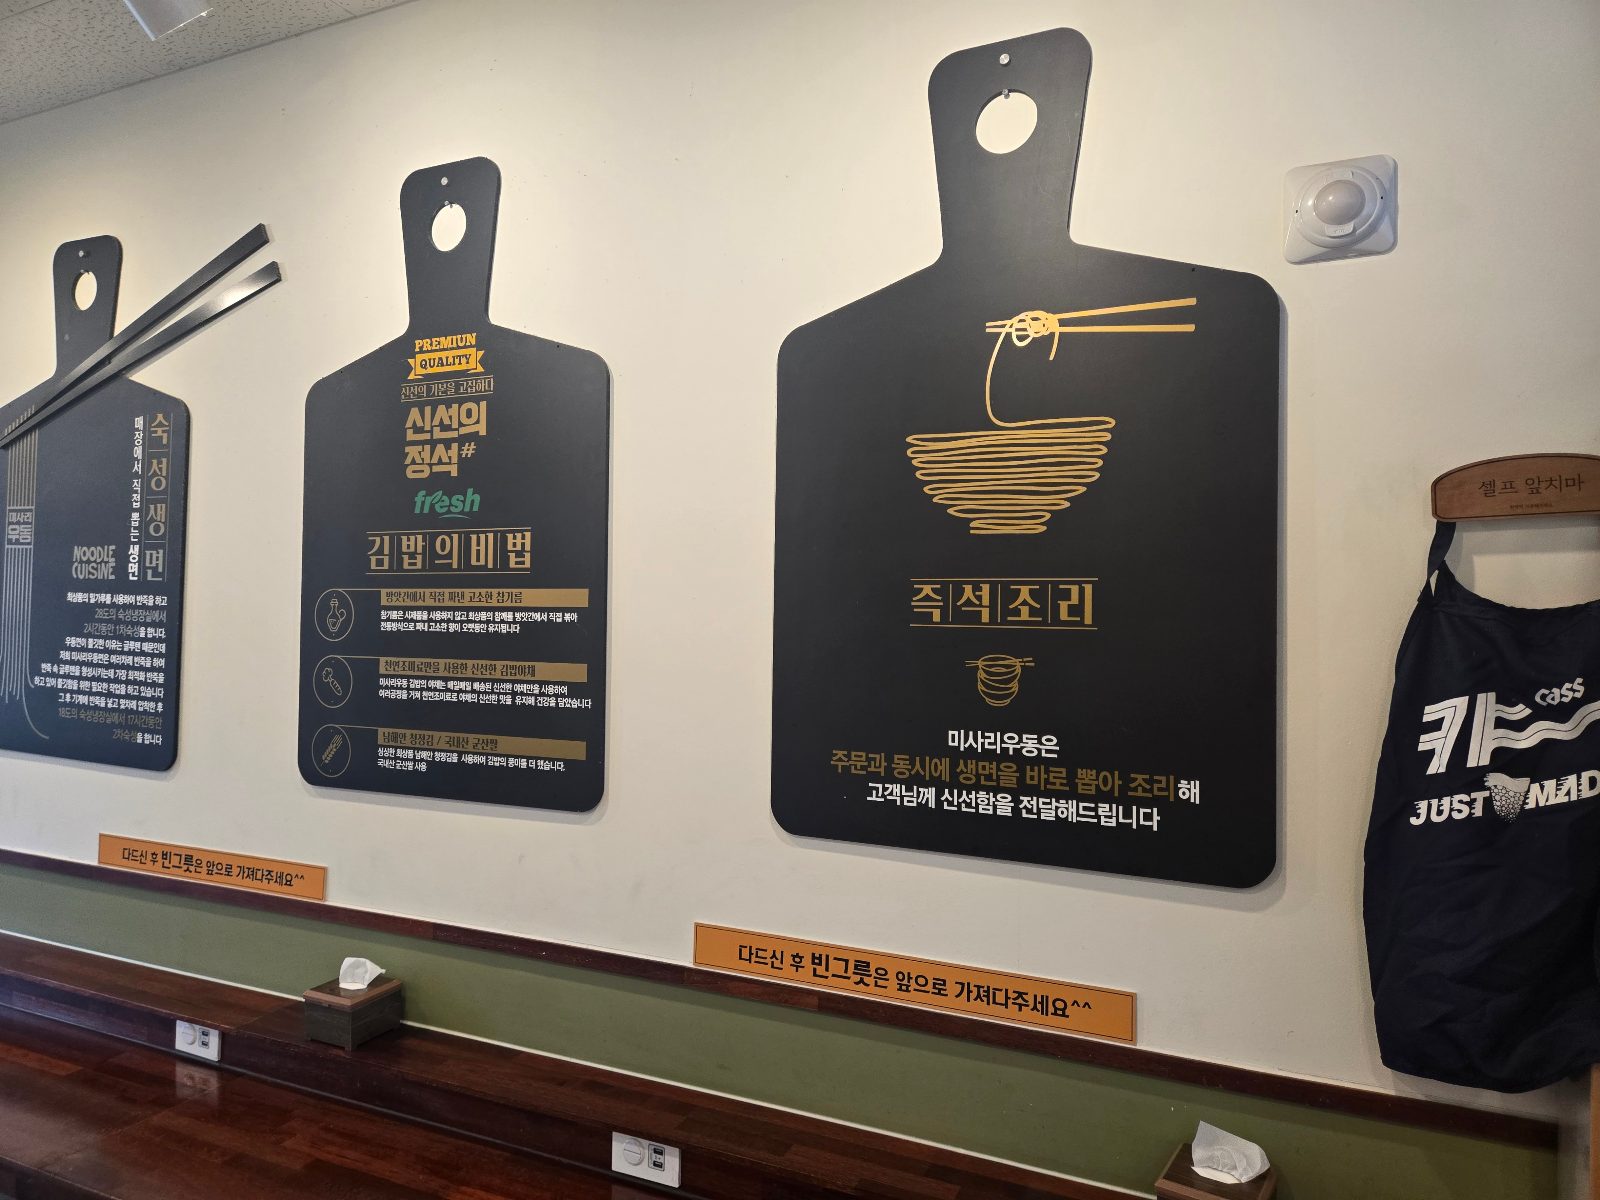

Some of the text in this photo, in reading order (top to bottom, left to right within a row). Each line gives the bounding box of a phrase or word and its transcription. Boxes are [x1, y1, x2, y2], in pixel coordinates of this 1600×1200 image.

[414, 332, 476, 352] PREMIUN
[419, 353, 472, 370] QUALITY
[429, 381, 456, 397] 기본을
[458, 376, 494, 394] 고집하다
[405, 400, 487, 441] 신선의
[1478, 472, 1585, 497] 셀프 앞치마
[128, 415, 144, 581] 매장에서 직접 뽑는 생면
[414, 488, 481, 514] fresh
[8, 511, 32, 523] 미사리
[7, 524, 32, 543] 우동
[73, 545, 116, 562] NOODLE
[72, 561, 116, 580] CUISINE
[89, 592, 112, 605] 밀가루를
[112, 594, 136, 606] 사용하여
[136, 595, 155, 606] 반죽을
[155, 595, 168, 606] 하고
[385, 591, 426, 603] 방앗간에서
[429, 591, 445, 603] 직접
[467, 591, 493, 603] 고소한
[496, 591, 522, 603] 참기름
[117, 609, 167, 623] 숙성냉장실에서
[380, 610, 404, 620] 참기름은
[429, 610, 454, 621] 사용하지
[454, 611, 467, 621] 않고
[514, 612, 548, 622] 방앗간에서
[549, 612, 563, 622] 직접
[84, 622, 114, 636] 2시간동안
[380, 621, 415, 631] 전통방식으로
[428, 622, 447, 632] 고소한
[448, 622, 461, 632] 향이
[461, 623, 487, 633] 오랫동안
[488, 623, 520, 634] 유지됩니다
[65, 636, 87, 648] 우동면이
[105, 639, 123, 651] 이유는
[123, 640, 141, 652] 글루텐
[141, 641, 166, 654] 때문인데
[60, 651, 166, 668] 저희 미사리우동면은 여러차례 반죽을 하여
[384, 660, 536, 678] 천연조미료만을 사용한 신선한 김밥야채
[41, 662, 52, 673] 반죽
[59, 664, 81, 676] 글루텐을
[115, 669, 127, 680] 가장
[146, 671, 165, 684] 반죽을
[34, 675, 45, 686] 하고
[79, 680, 91, 691] 위한
[91, 681, 108, 693] 필요한
[109, 683, 126, 695] 작업을
[127, 684, 139, 695] 하고
[140, 686, 164, 698] 있습니다
[379, 678, 408, 688] 미사리우동
[409, 679, 427, 689] 김밥의
[427, 679, 446, 690] 야채는
[472, 681, 492, 692] 배송된
[493, 682, 512, 693] 신선한
[513, 683, 540, 694] 야채만을
[541, 684, 568, 695] 사용하여
[58, 693, 65, 703] 그
[65, 693, 72, 704] 후
[71, 694, 89, 706] 기계에
[89, 696, 106, 708] 반죽을
[157, 702, 164, 714] 후
[379, 689, 592, 709] 여러공정을 거쳐 천연조미료로 야채의 신선한 맛을 유지해 건강을 담았습니다
[79, 708, 126, 726] 숙성냉장실에서
[128, 714, 163, 730] 17시간동안
[144, 733, 163, 746] 합니다
[382, 731, 407, 745] 남해안
[409, 733, 434, 747] 청정김
[445, 736, 469, 749] 국내산
[947, 729, 1060, 759] 미사리우동은
[377, 759, 395, 769] 국내산
[414, 761, 427, 772] 사용
[415, 750, 434, 761] 남해안
[434, 751, 459, 763] 청정김을
[460, 753, 486, 766] 사용하여
[487, 755, 507, 767] 김밥의
[508, 757, 528, 769] 풍미를
[528, 759, 536, 769] 더
[830, 749, 887, 777] 주문과
[891, 753, 951, 782] 동시에
[956, 760, 1020, 788] 생면을
[1025, 764, 1070, 792] 바로
[1075, 768, 1122, 797] 뽑아
[866, 781, 1161, 832] 고객님께 신선함을 전달해드립니다
[1410, 789, 1490, 826] JUST
[121, 847, 148, 865] 다드신
[150, 852, 159, 867] 후
[161, 849, 203, 874] 빈그릇은
[206, 861, 233, 878] 앞으로
[738, 943, 785, 972] 다드신
[790, 952, 806, 974] 후
[811, 951, 890, 989] 빈그릇은
[894, 970, 948, 999] 앞으로
